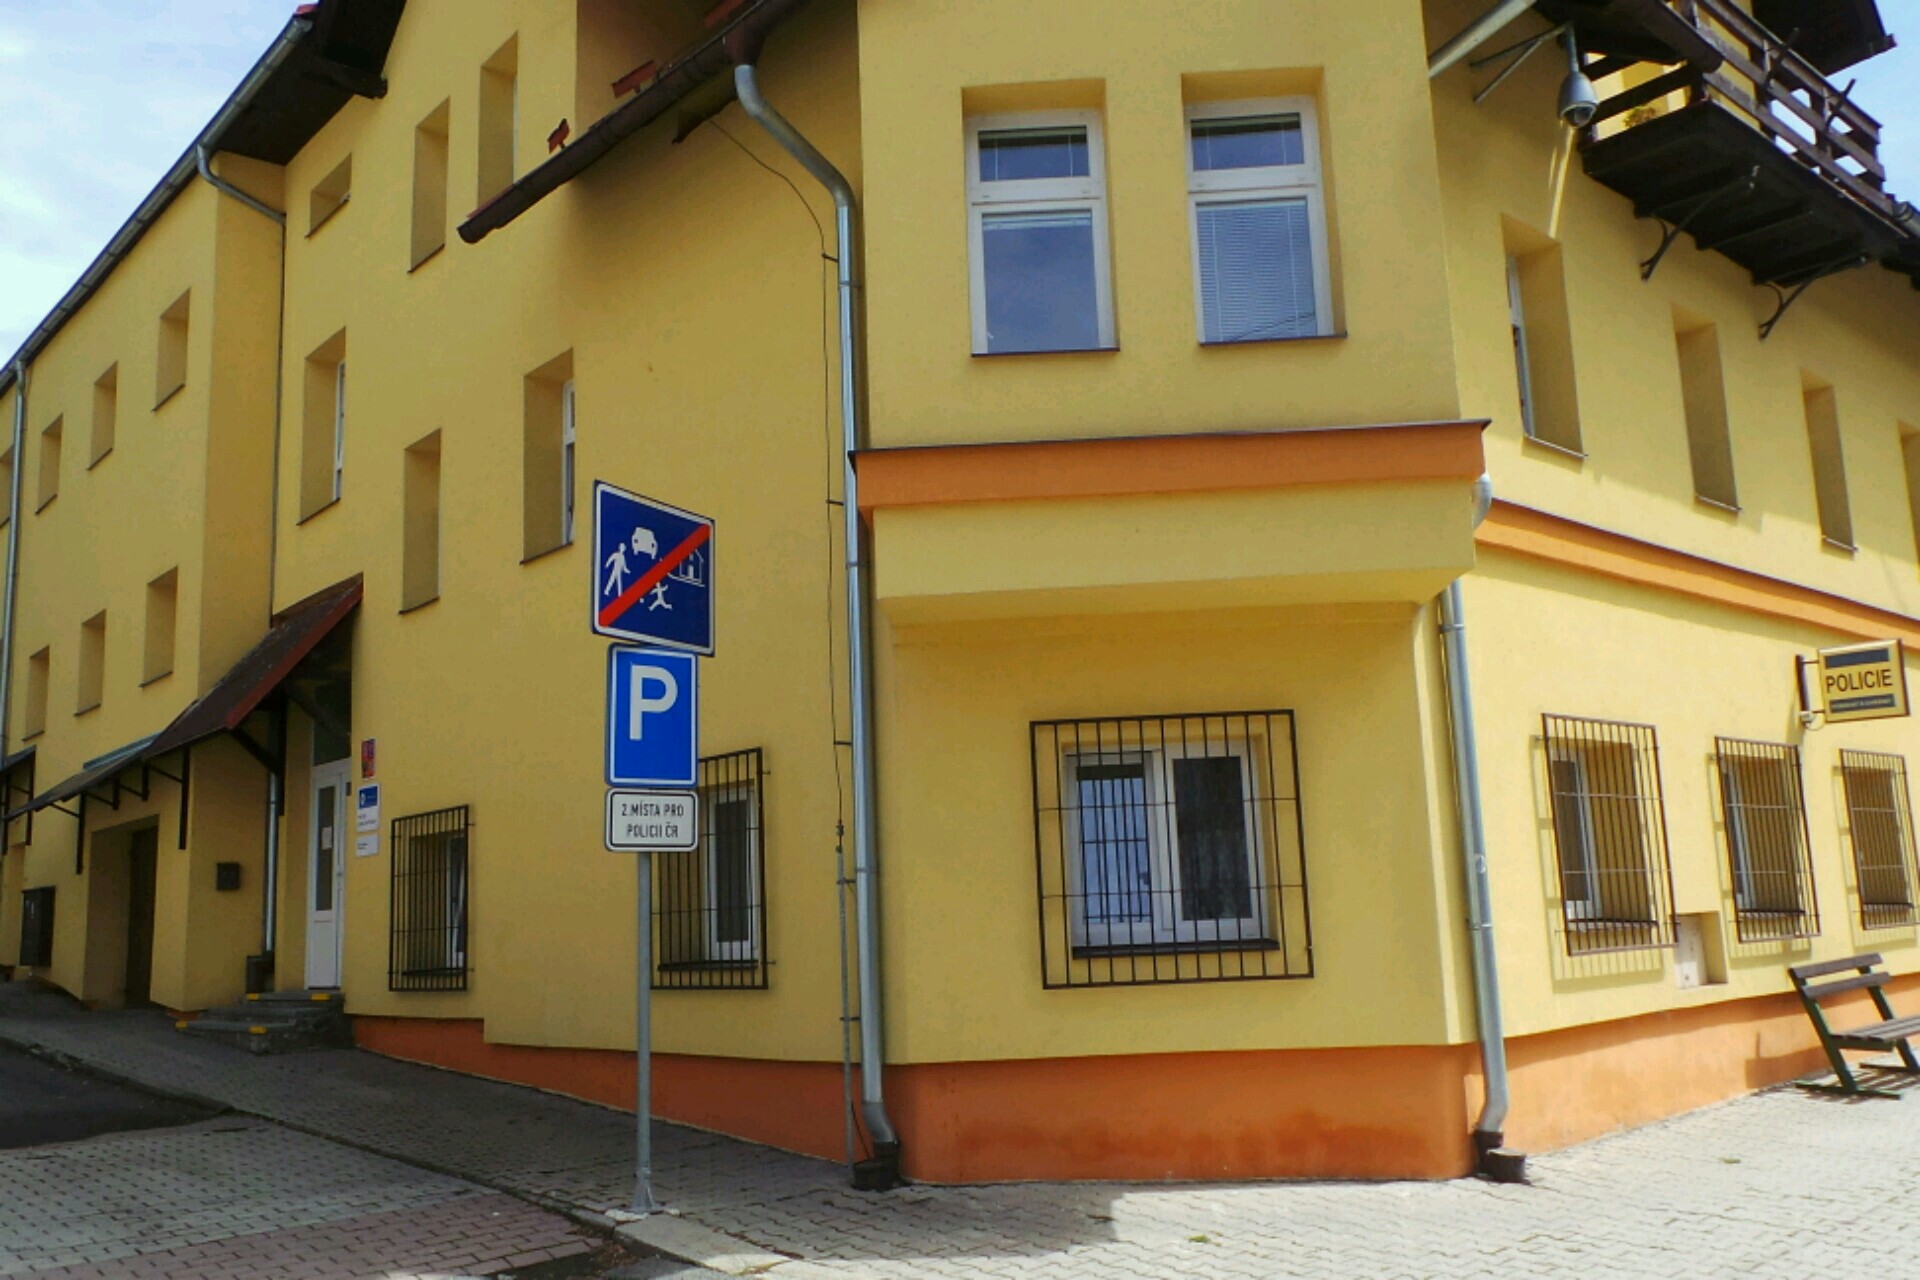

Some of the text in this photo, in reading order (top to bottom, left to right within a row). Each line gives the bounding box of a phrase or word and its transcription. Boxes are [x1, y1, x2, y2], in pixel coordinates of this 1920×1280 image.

[1825, 669, 1893, 694] POLICIE
[629, 664, 678, 741] P
[664, 803, 684, 817] PRO
[627, 821, 679, 838] POLICII ČR
